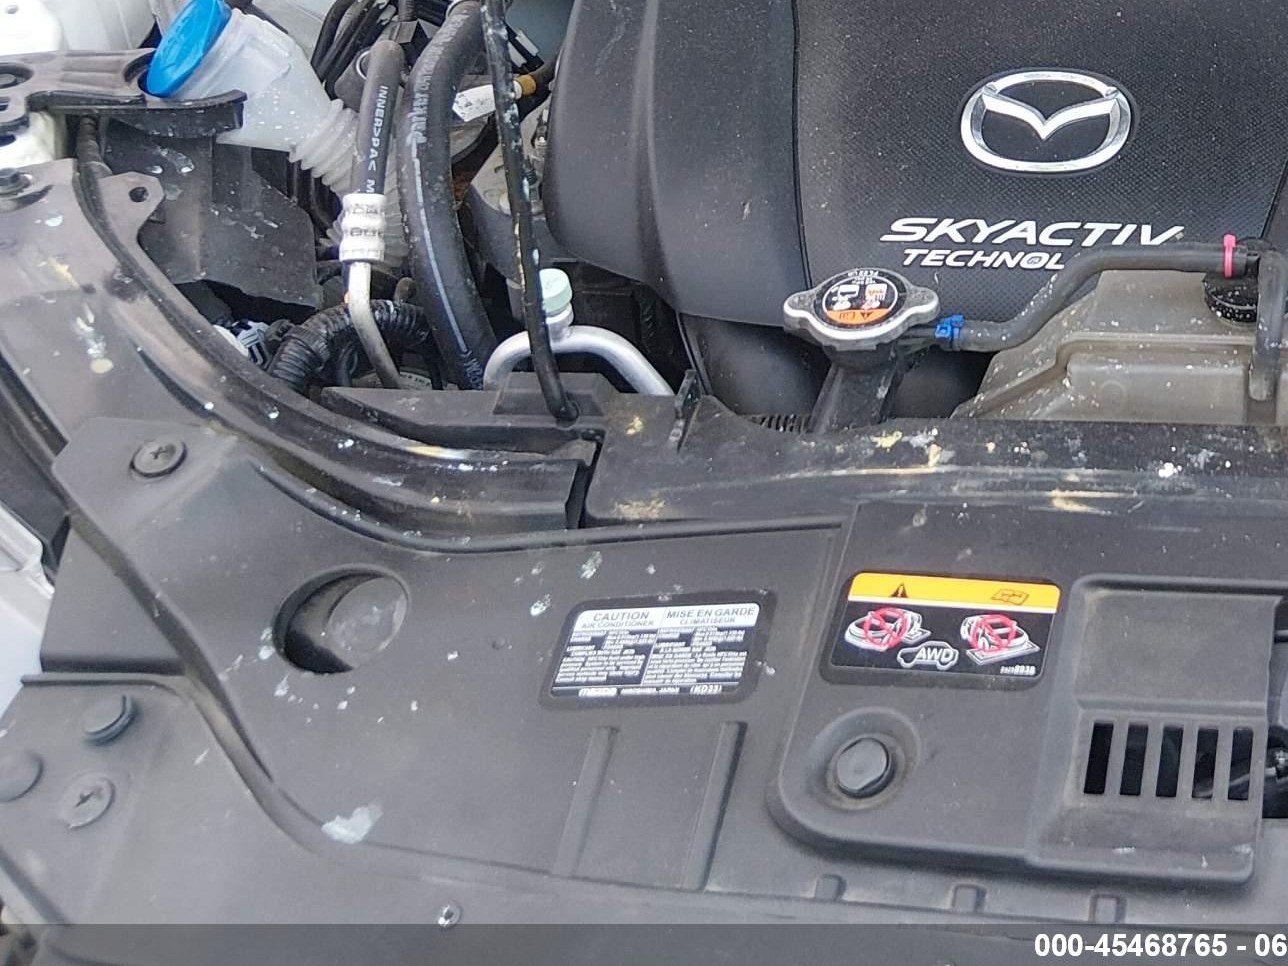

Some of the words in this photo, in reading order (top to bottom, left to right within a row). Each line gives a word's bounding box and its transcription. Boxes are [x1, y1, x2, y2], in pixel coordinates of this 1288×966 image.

[880, 217, 1185, 247] SKYACTIV
[903, 248, 1065, 270] TECHNOL
[593, 611, 649, 621] CAUTION
[666, 609, 694, 619] MISE
[696, 609, 715, 618] EN
[716, 607, 756, 617] GARDE
[599, 620, 654, 628] CONDITIONER
[915, 647, 954, 663] AWD
